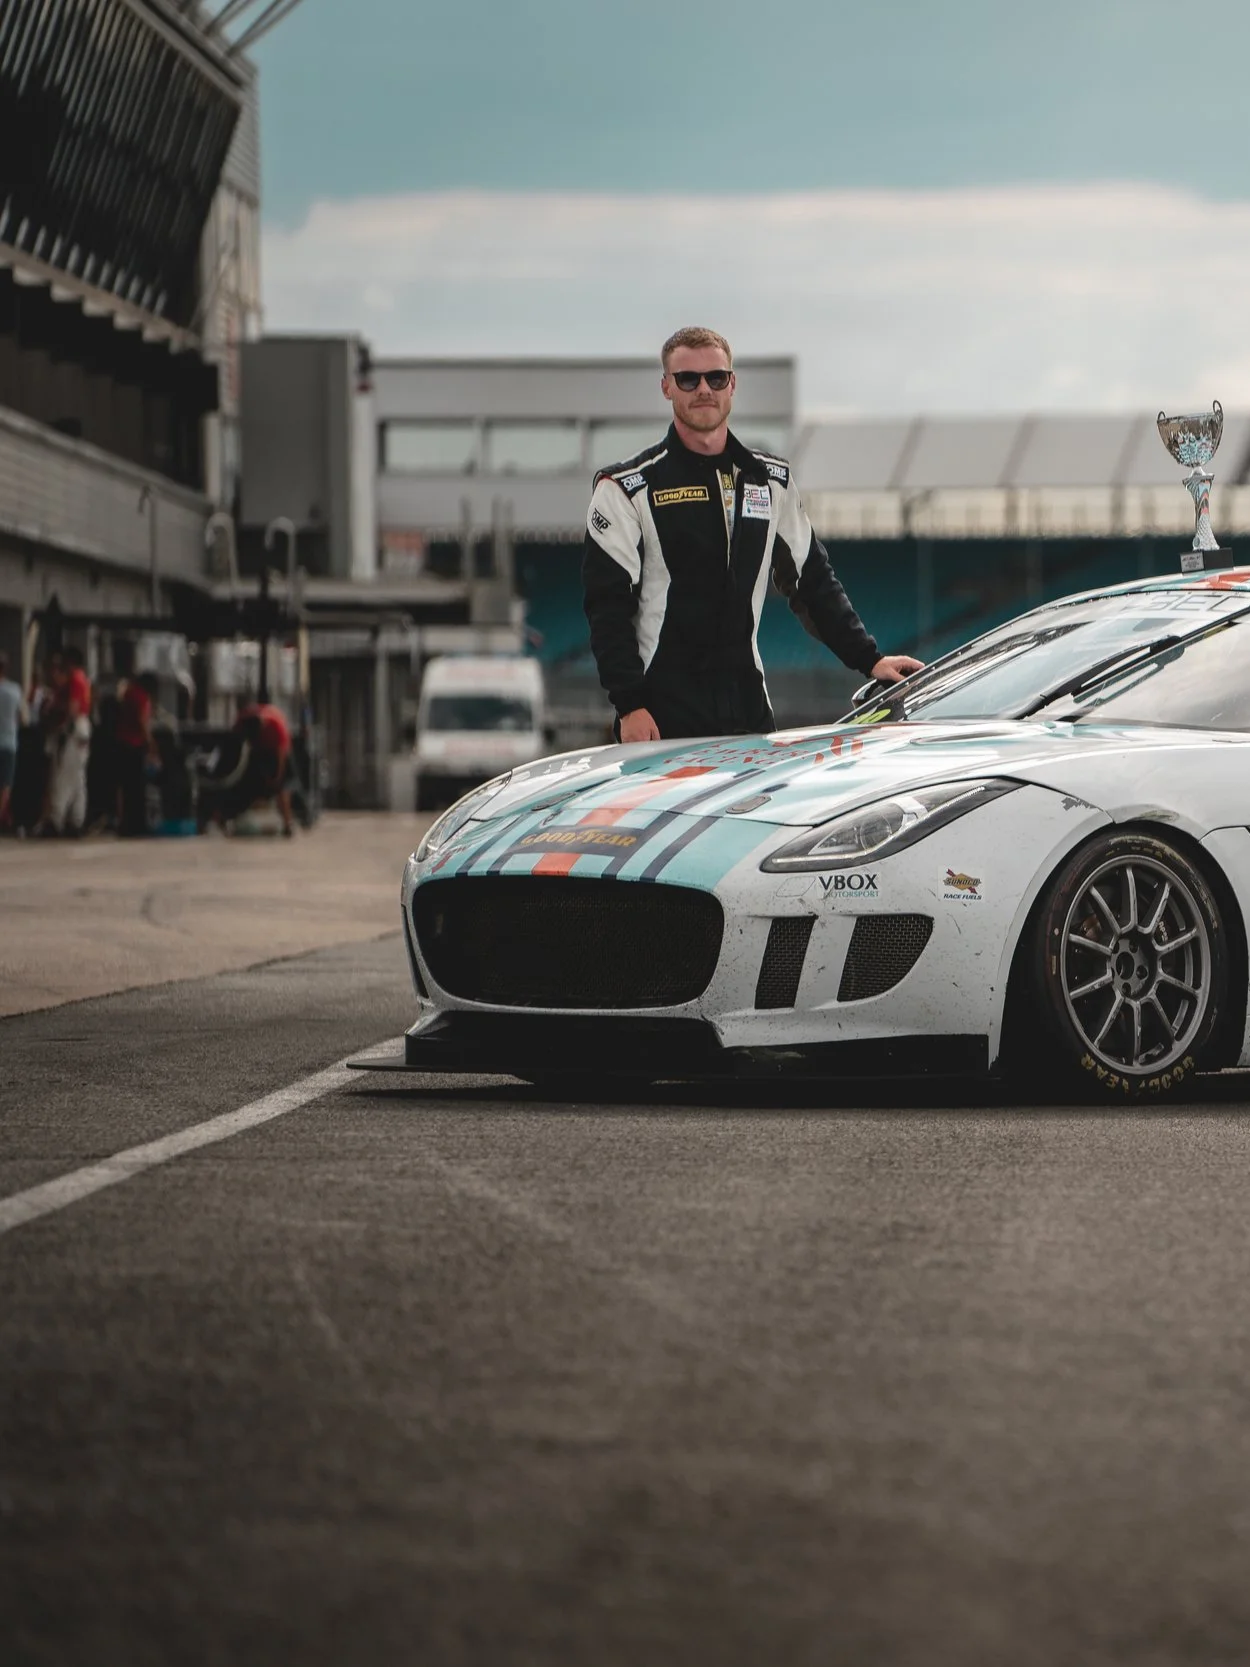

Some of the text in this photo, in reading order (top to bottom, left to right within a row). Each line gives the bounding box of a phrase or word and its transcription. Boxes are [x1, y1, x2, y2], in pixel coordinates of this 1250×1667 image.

[767, 465, 787, 478] OMP
[624, 474, 643, 489] OMP
[658, 490, 705, 501] GOODYEAR
[592, 511, 609, 530] OMP
[521, 829, 637, 847] GOODYEAR
[818, 874, 878, 890] VBOX
[944, 878, 981, 886] SUNOCO
[824, 890, 879, 898] MOTORSPORT
